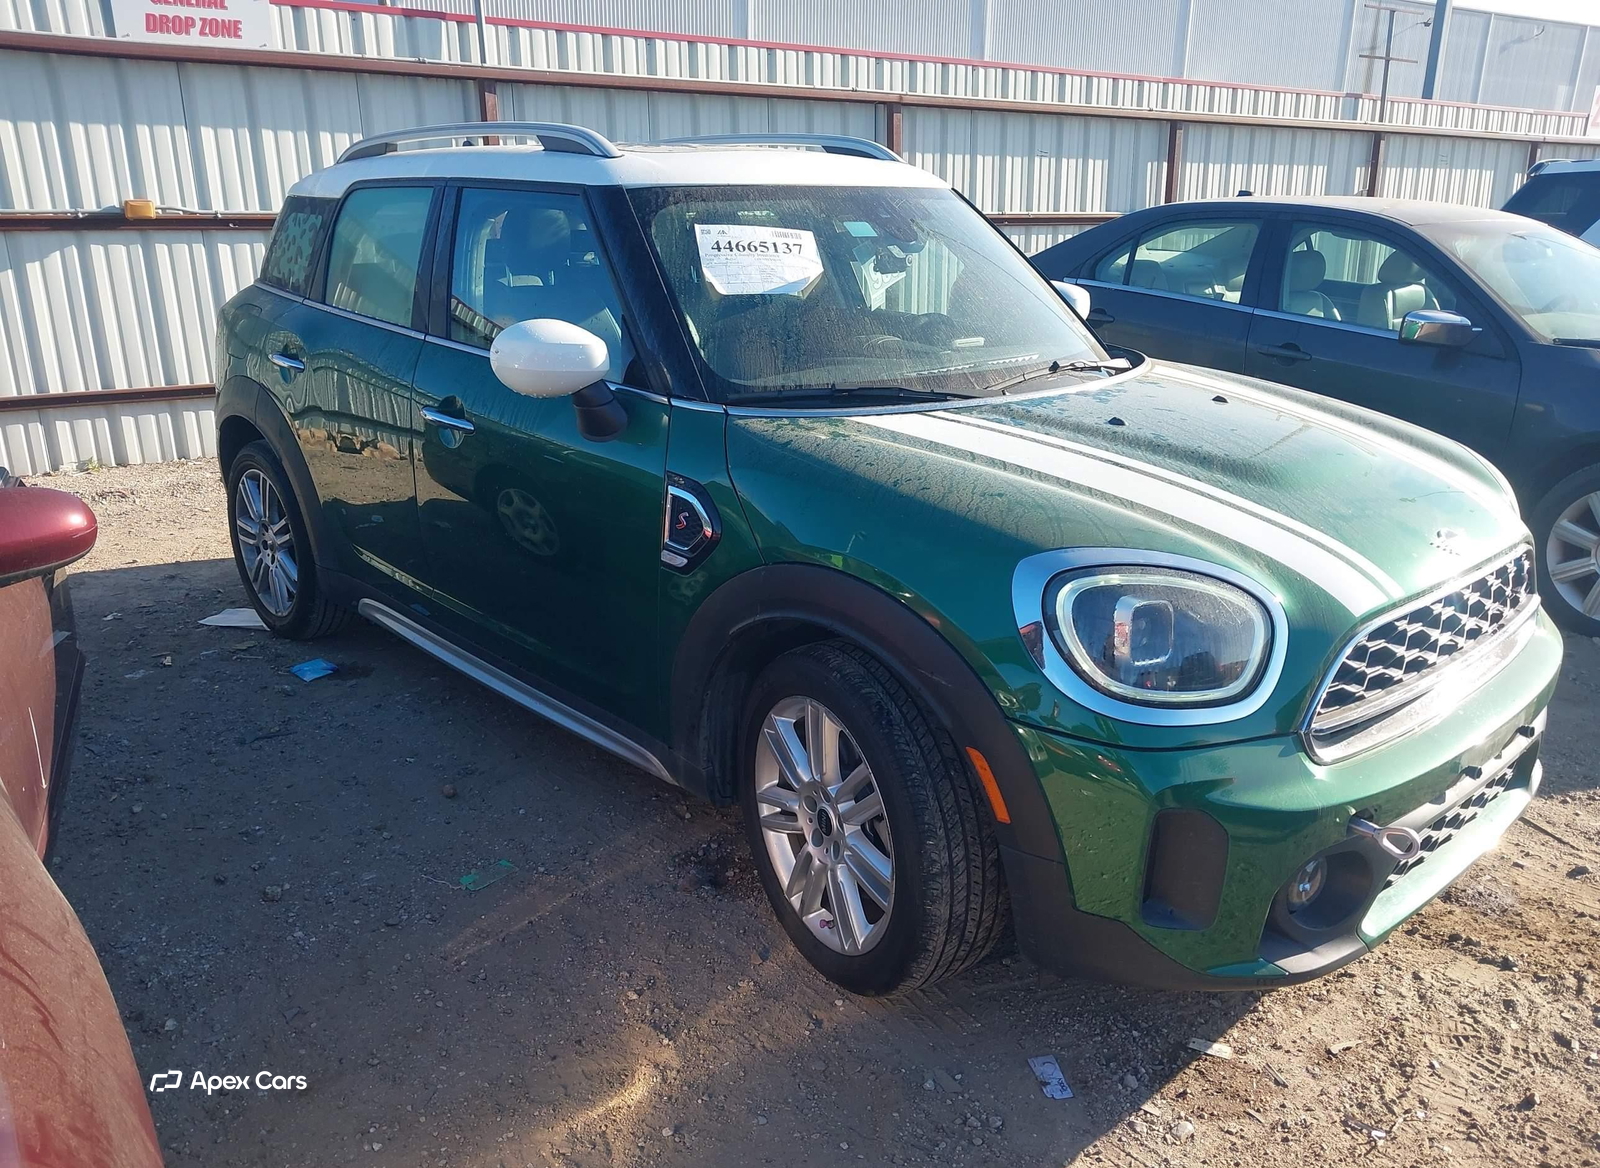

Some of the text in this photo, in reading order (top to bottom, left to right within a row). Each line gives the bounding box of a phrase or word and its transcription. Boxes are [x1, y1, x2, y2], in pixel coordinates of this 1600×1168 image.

[145, 13, 242, 39] DROP ZONE
[711, 240, 803, 255] 44665137
[675, 511, 689, 530] S
